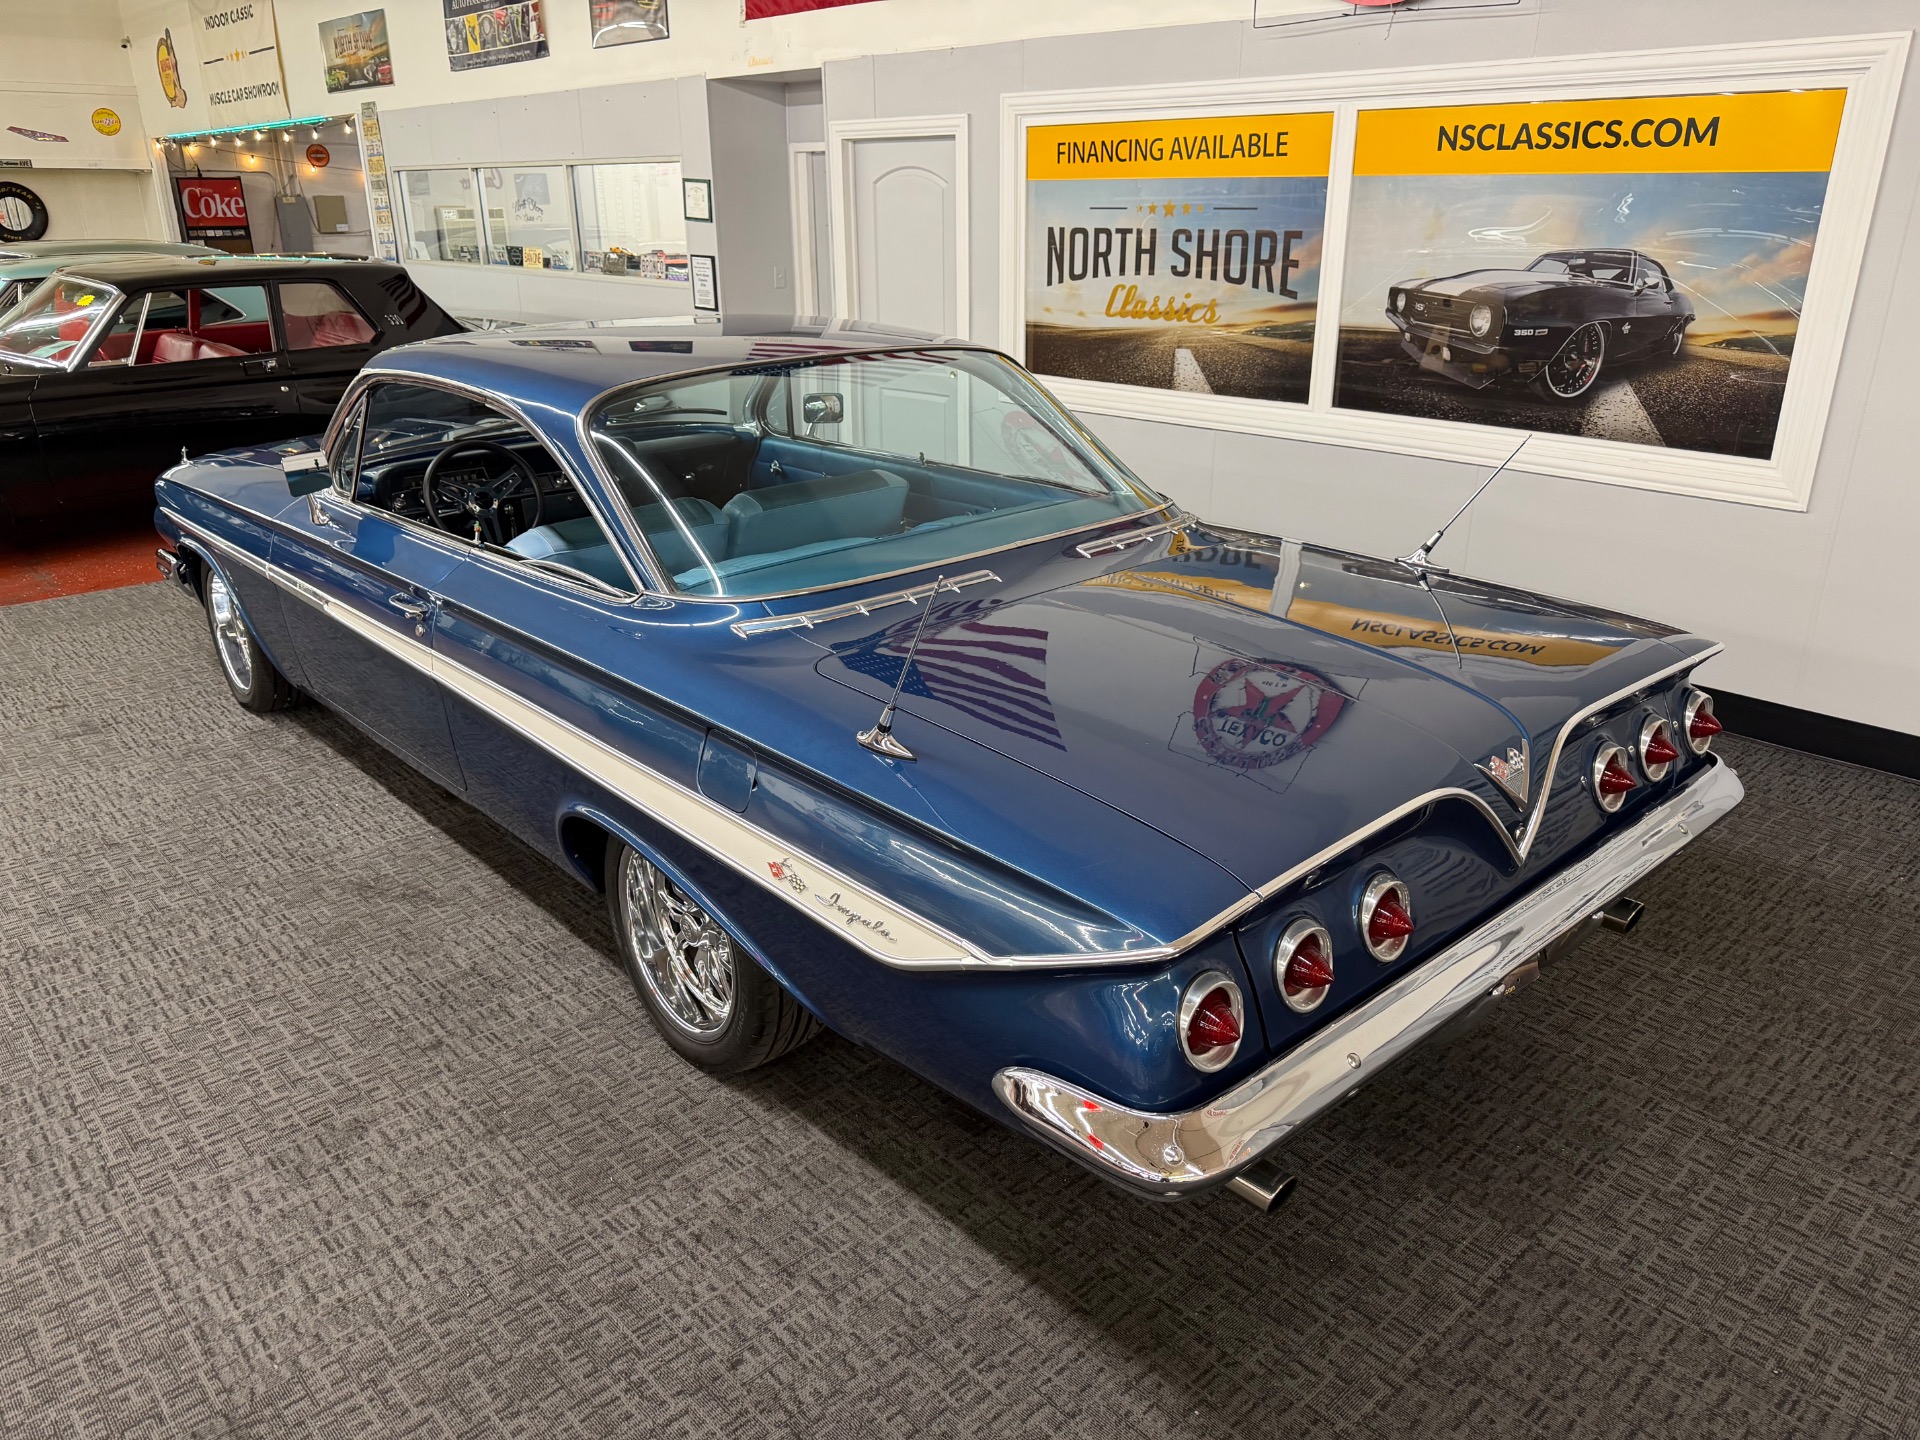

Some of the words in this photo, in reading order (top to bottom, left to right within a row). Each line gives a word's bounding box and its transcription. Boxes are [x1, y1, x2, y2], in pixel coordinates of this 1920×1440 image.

[203, 12, 229, 30] INDOOR
[230, 4, 254, 24] CLASSIC
[209, 90, 232, 106] MUSCLE
[232, 87, 244, 102] CAR
[245, 80, 280, 100] SHOWROOM
[1056, 137, 1164, 164] FINANCING
[1169, 131, 1289, 161] AVAILABLE
[1437, 116, 1721, 152] NSCLASSICS.COM
[182, 187, 246, 218] Coke
[1047, 226, 1158, 287] NORTH
[1170, 228, 1303, 301] SHORE
[384, 314, 404, 326] 330
[1104, 283, 1222, 325] Classics
[1513, 328, 1534, 337] 350
[822, 891, 897, 943] Impala
